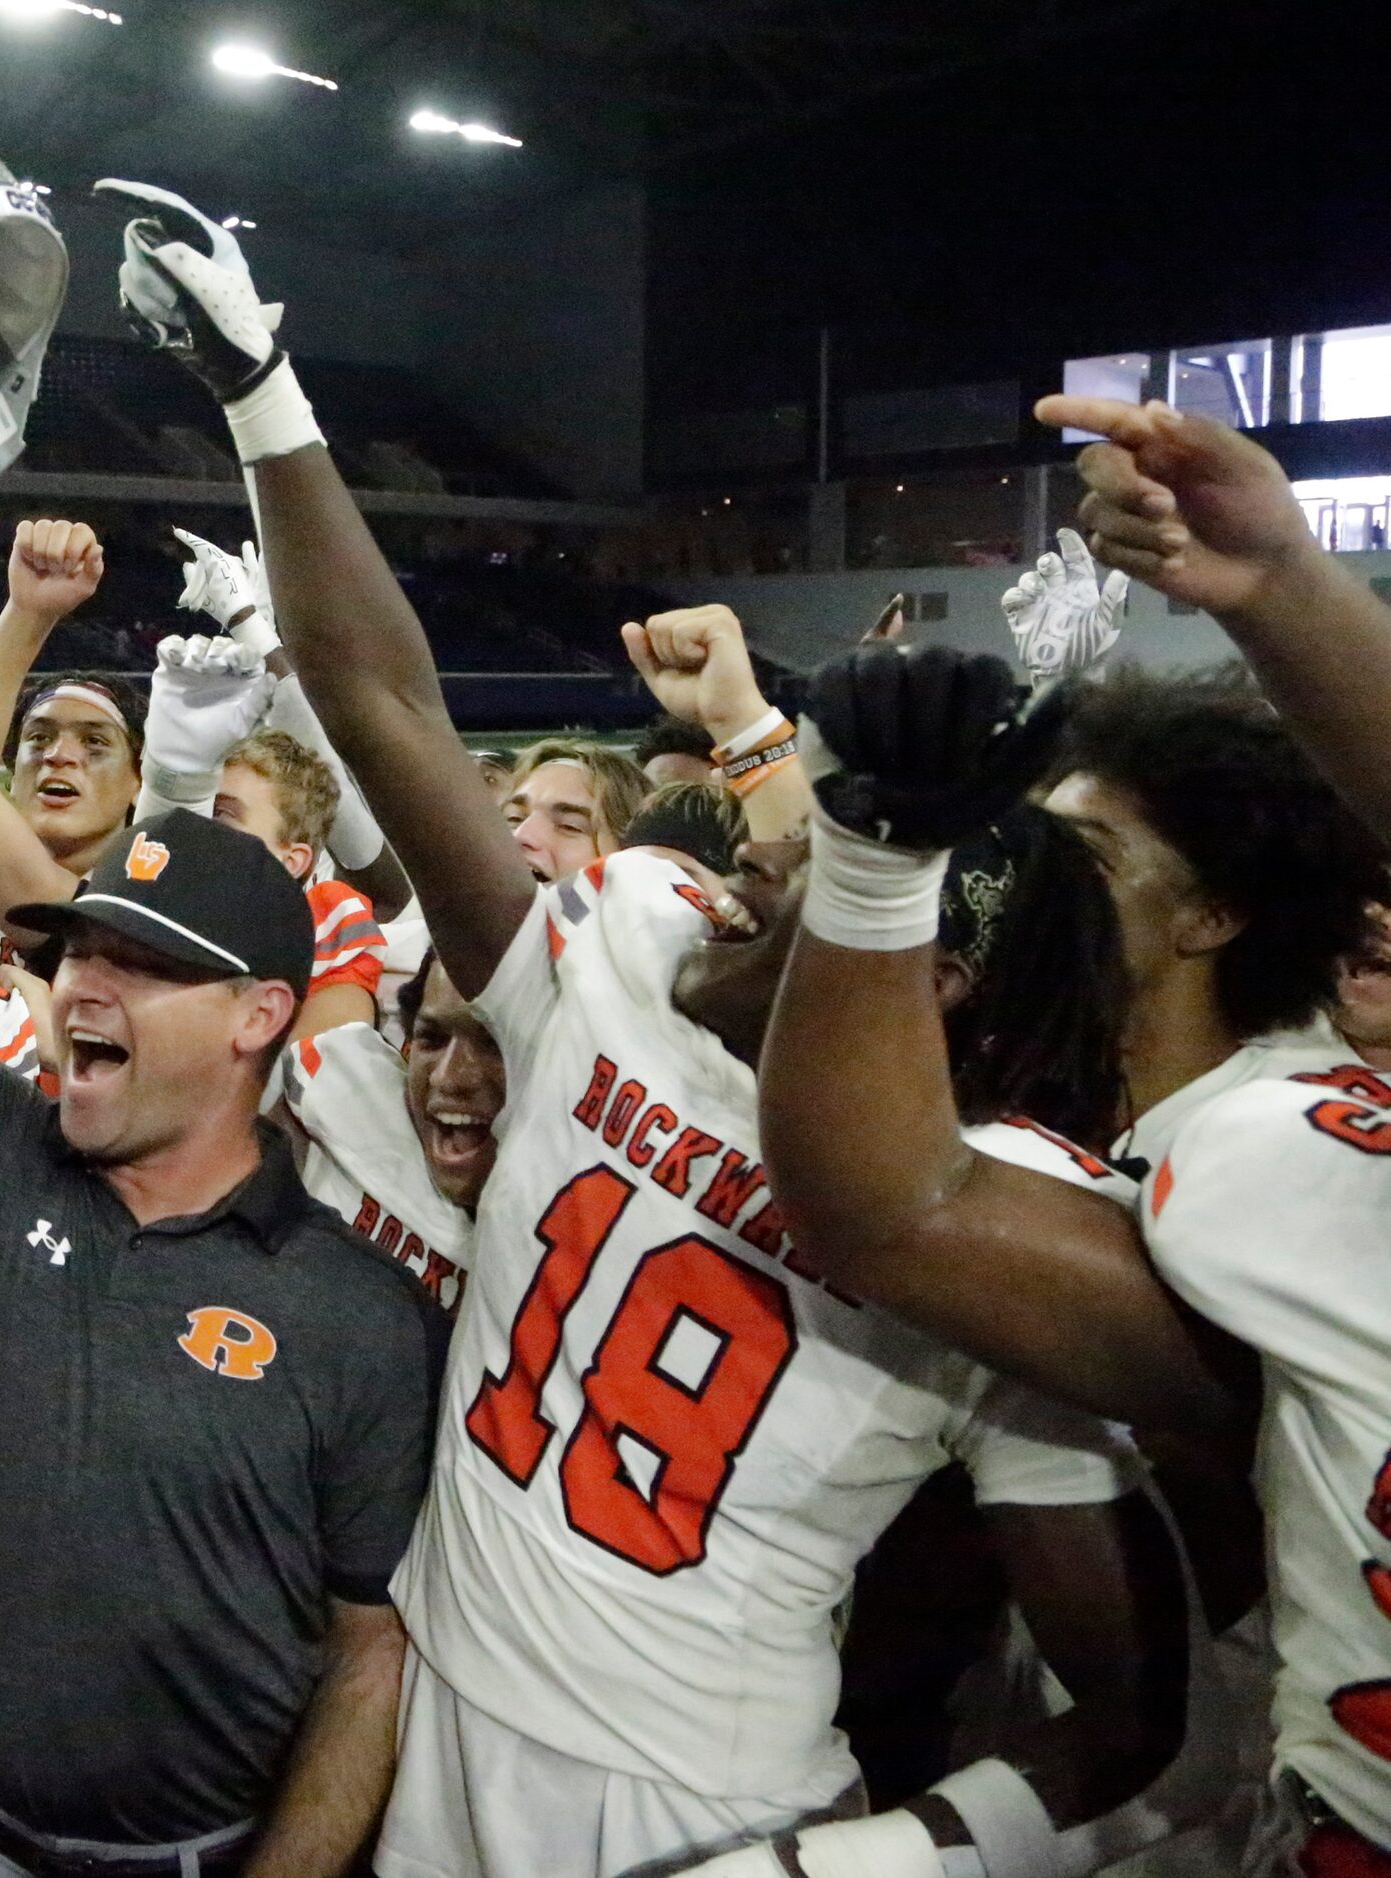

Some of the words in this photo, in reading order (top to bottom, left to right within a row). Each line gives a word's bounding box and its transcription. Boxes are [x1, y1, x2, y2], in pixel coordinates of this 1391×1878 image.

[352, 1191, 468, 1318] ROCK
[573, 1053, 862, 1309] ROCKWA
[177, 1306, 277, 1380] R
[465, 1161, 799, 1578] 18
